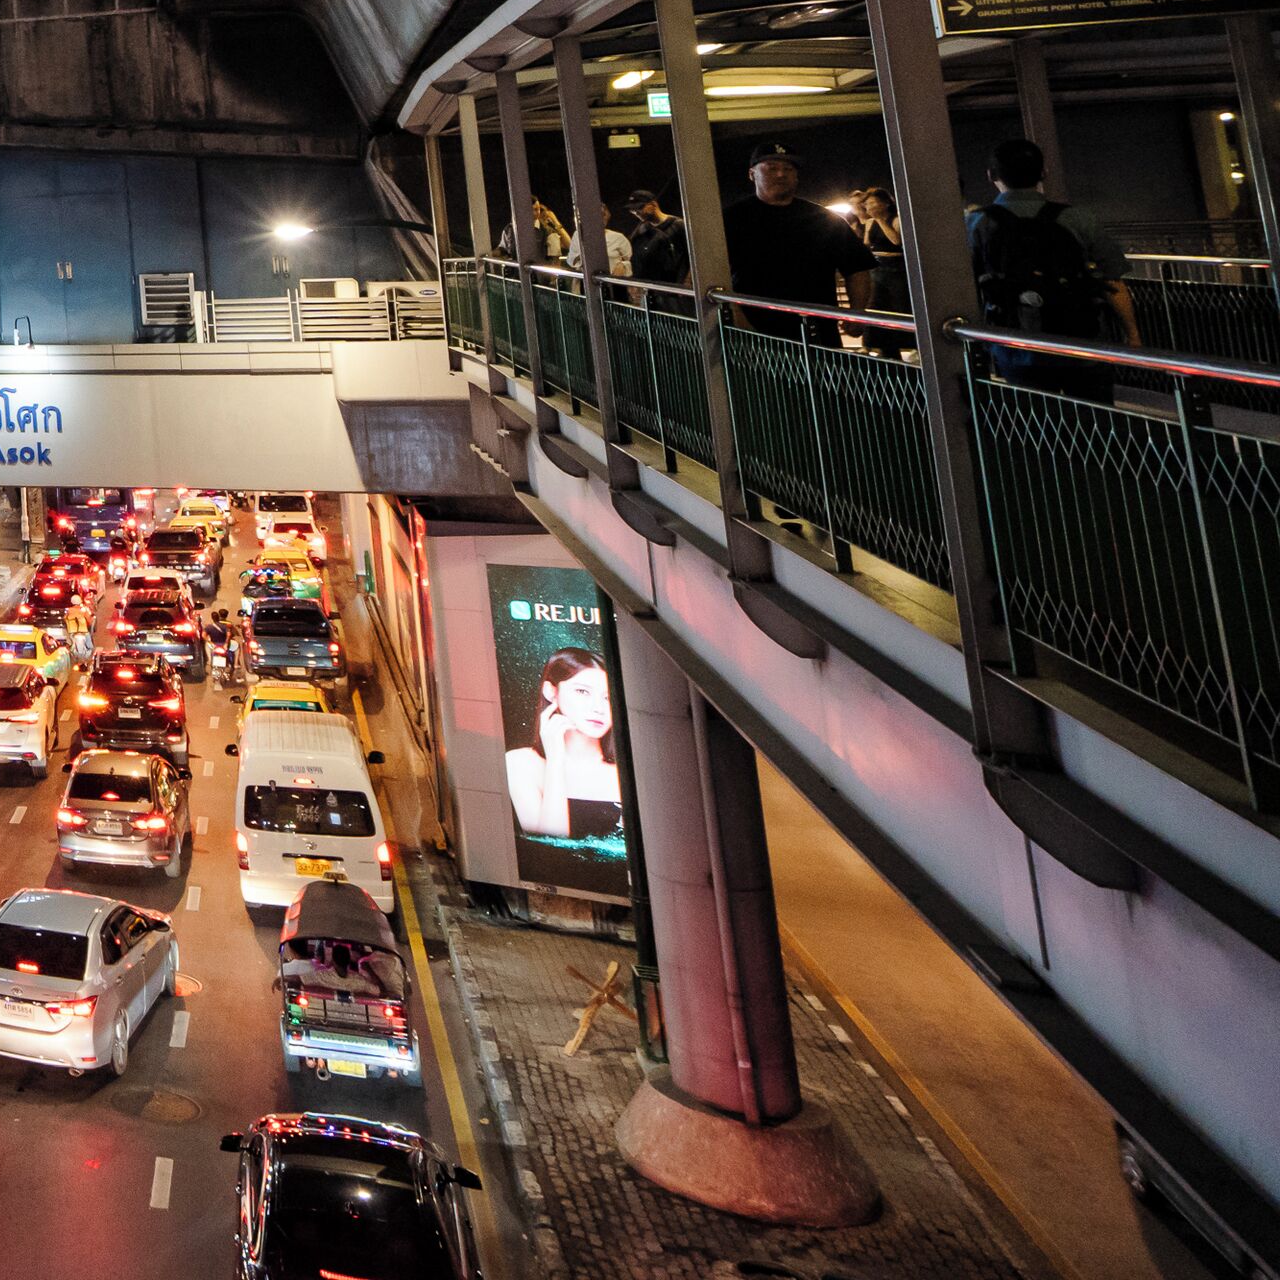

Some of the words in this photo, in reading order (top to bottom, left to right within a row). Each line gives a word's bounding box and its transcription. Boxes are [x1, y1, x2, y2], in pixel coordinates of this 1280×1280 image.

[977, 8, 1013, 18] GRANDE
[1014, 5, 1049, 15] CENTRE
[1051, 2, 1078, 12] POINT
[1078, 0, 1107, 9] HOTEL
